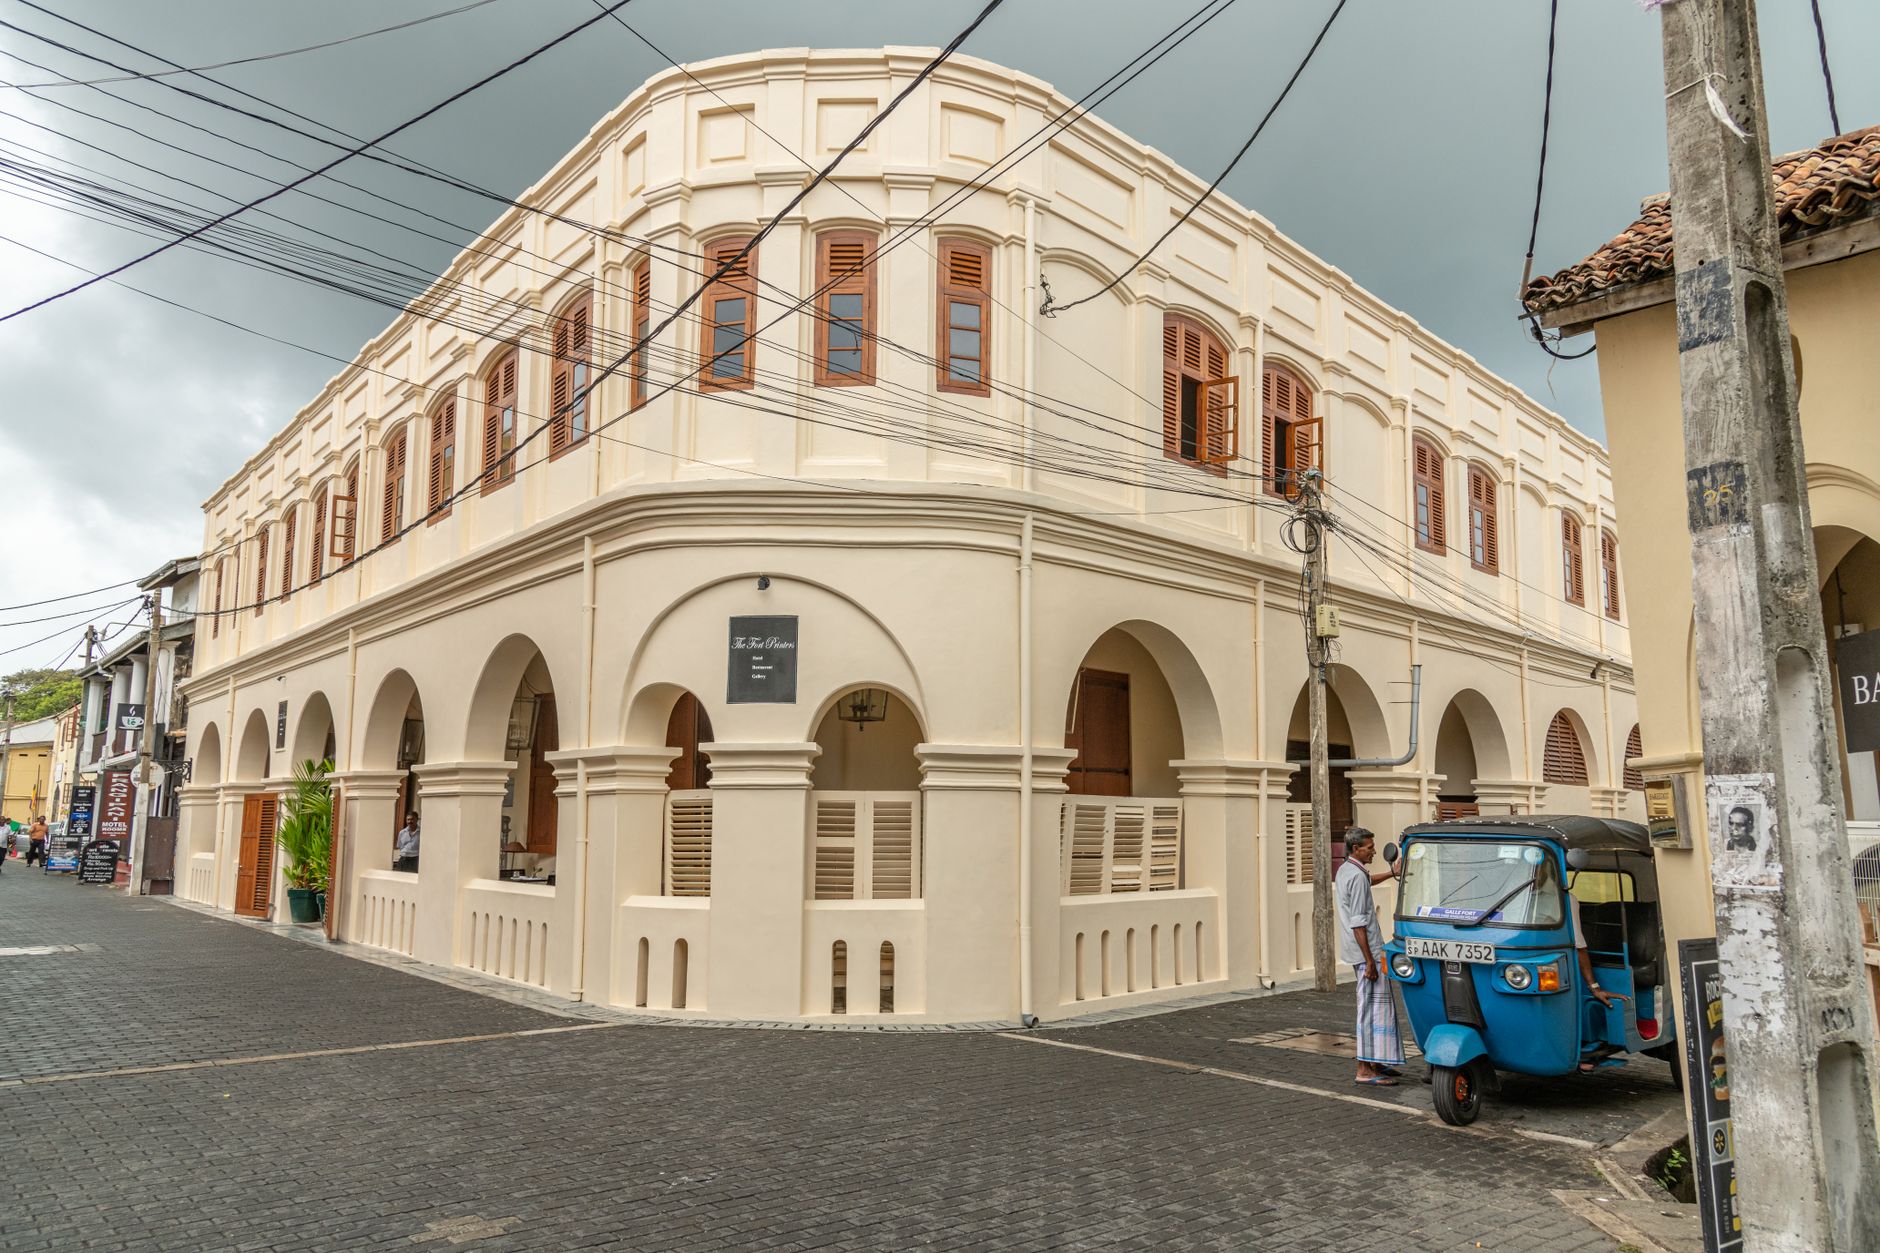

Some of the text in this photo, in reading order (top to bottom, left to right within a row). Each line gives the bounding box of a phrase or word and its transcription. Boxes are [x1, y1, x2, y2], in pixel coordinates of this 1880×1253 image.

[731, 636, 795, 649] The Fort Printers
[1422, 941, 1449, 957] AAK
[1455, 944, 1493, 961] 7352
